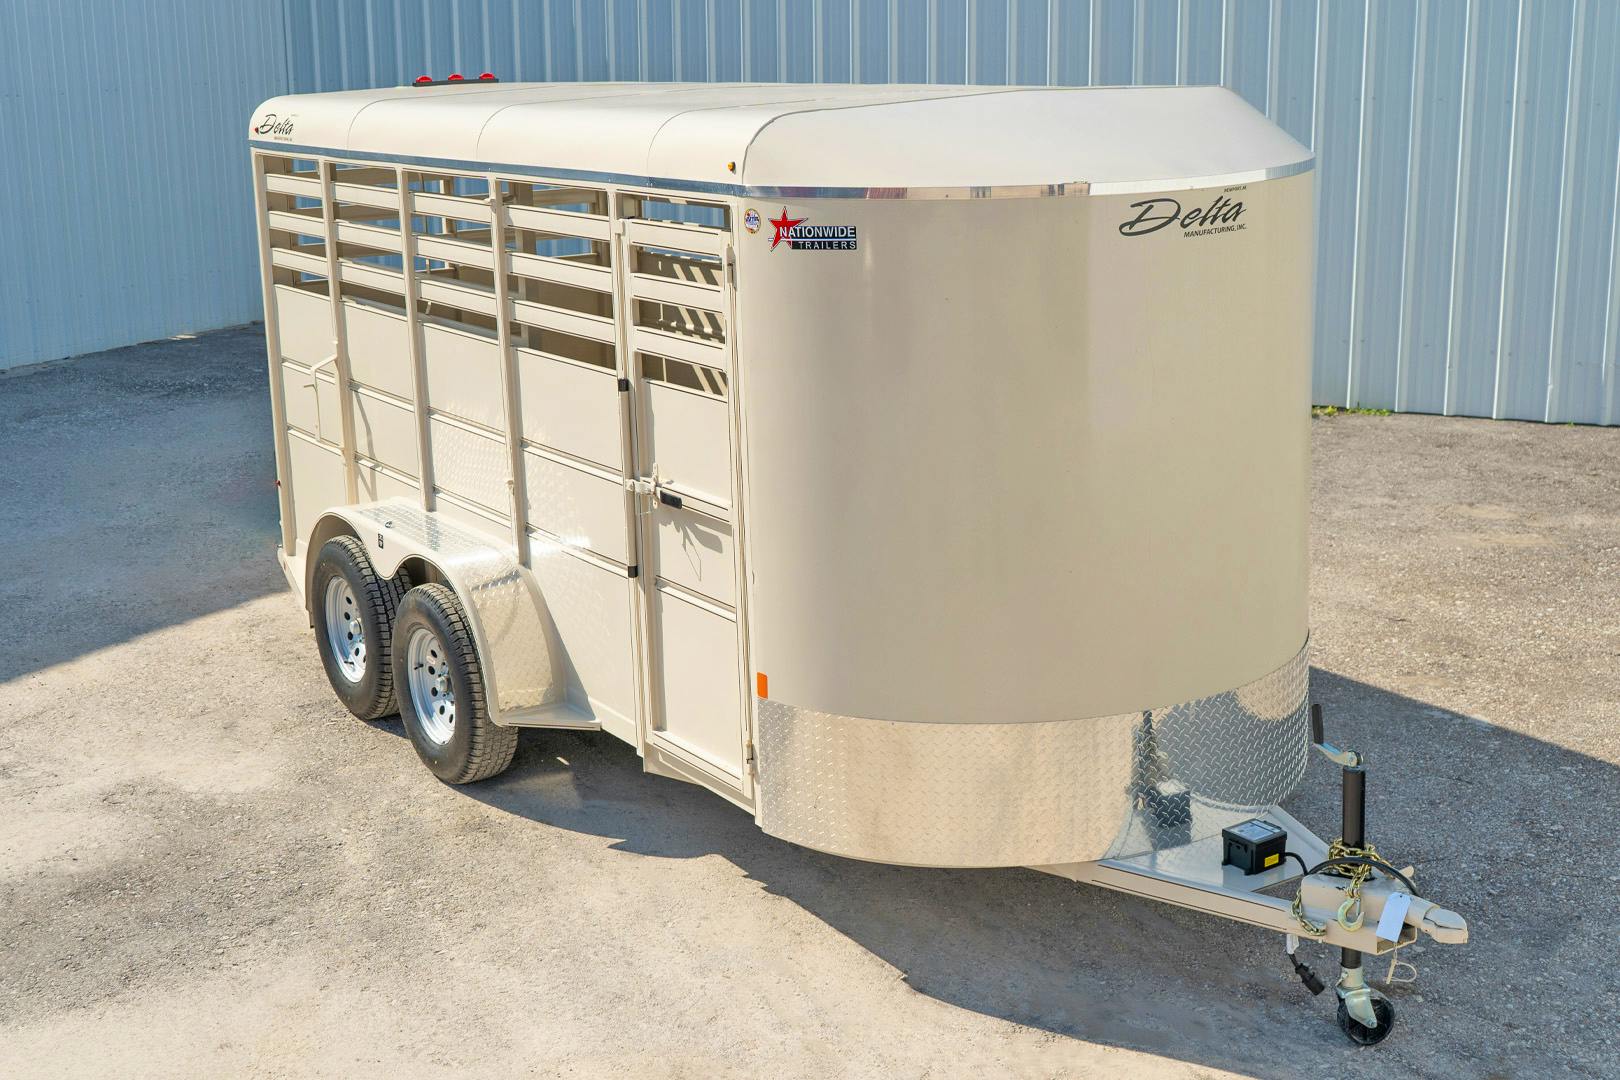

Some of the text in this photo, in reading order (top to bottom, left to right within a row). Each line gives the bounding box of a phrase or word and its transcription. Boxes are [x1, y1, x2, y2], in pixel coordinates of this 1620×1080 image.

[259, 113, 294, 135] Delta
[1118, 195, 1247, 237] Delta
[779, 226, 856, 238] NATIONWIDE
[1183, 225, 1237, 238] MANUFACTURING,
[799, 241, 856, 250] TRAILERS
